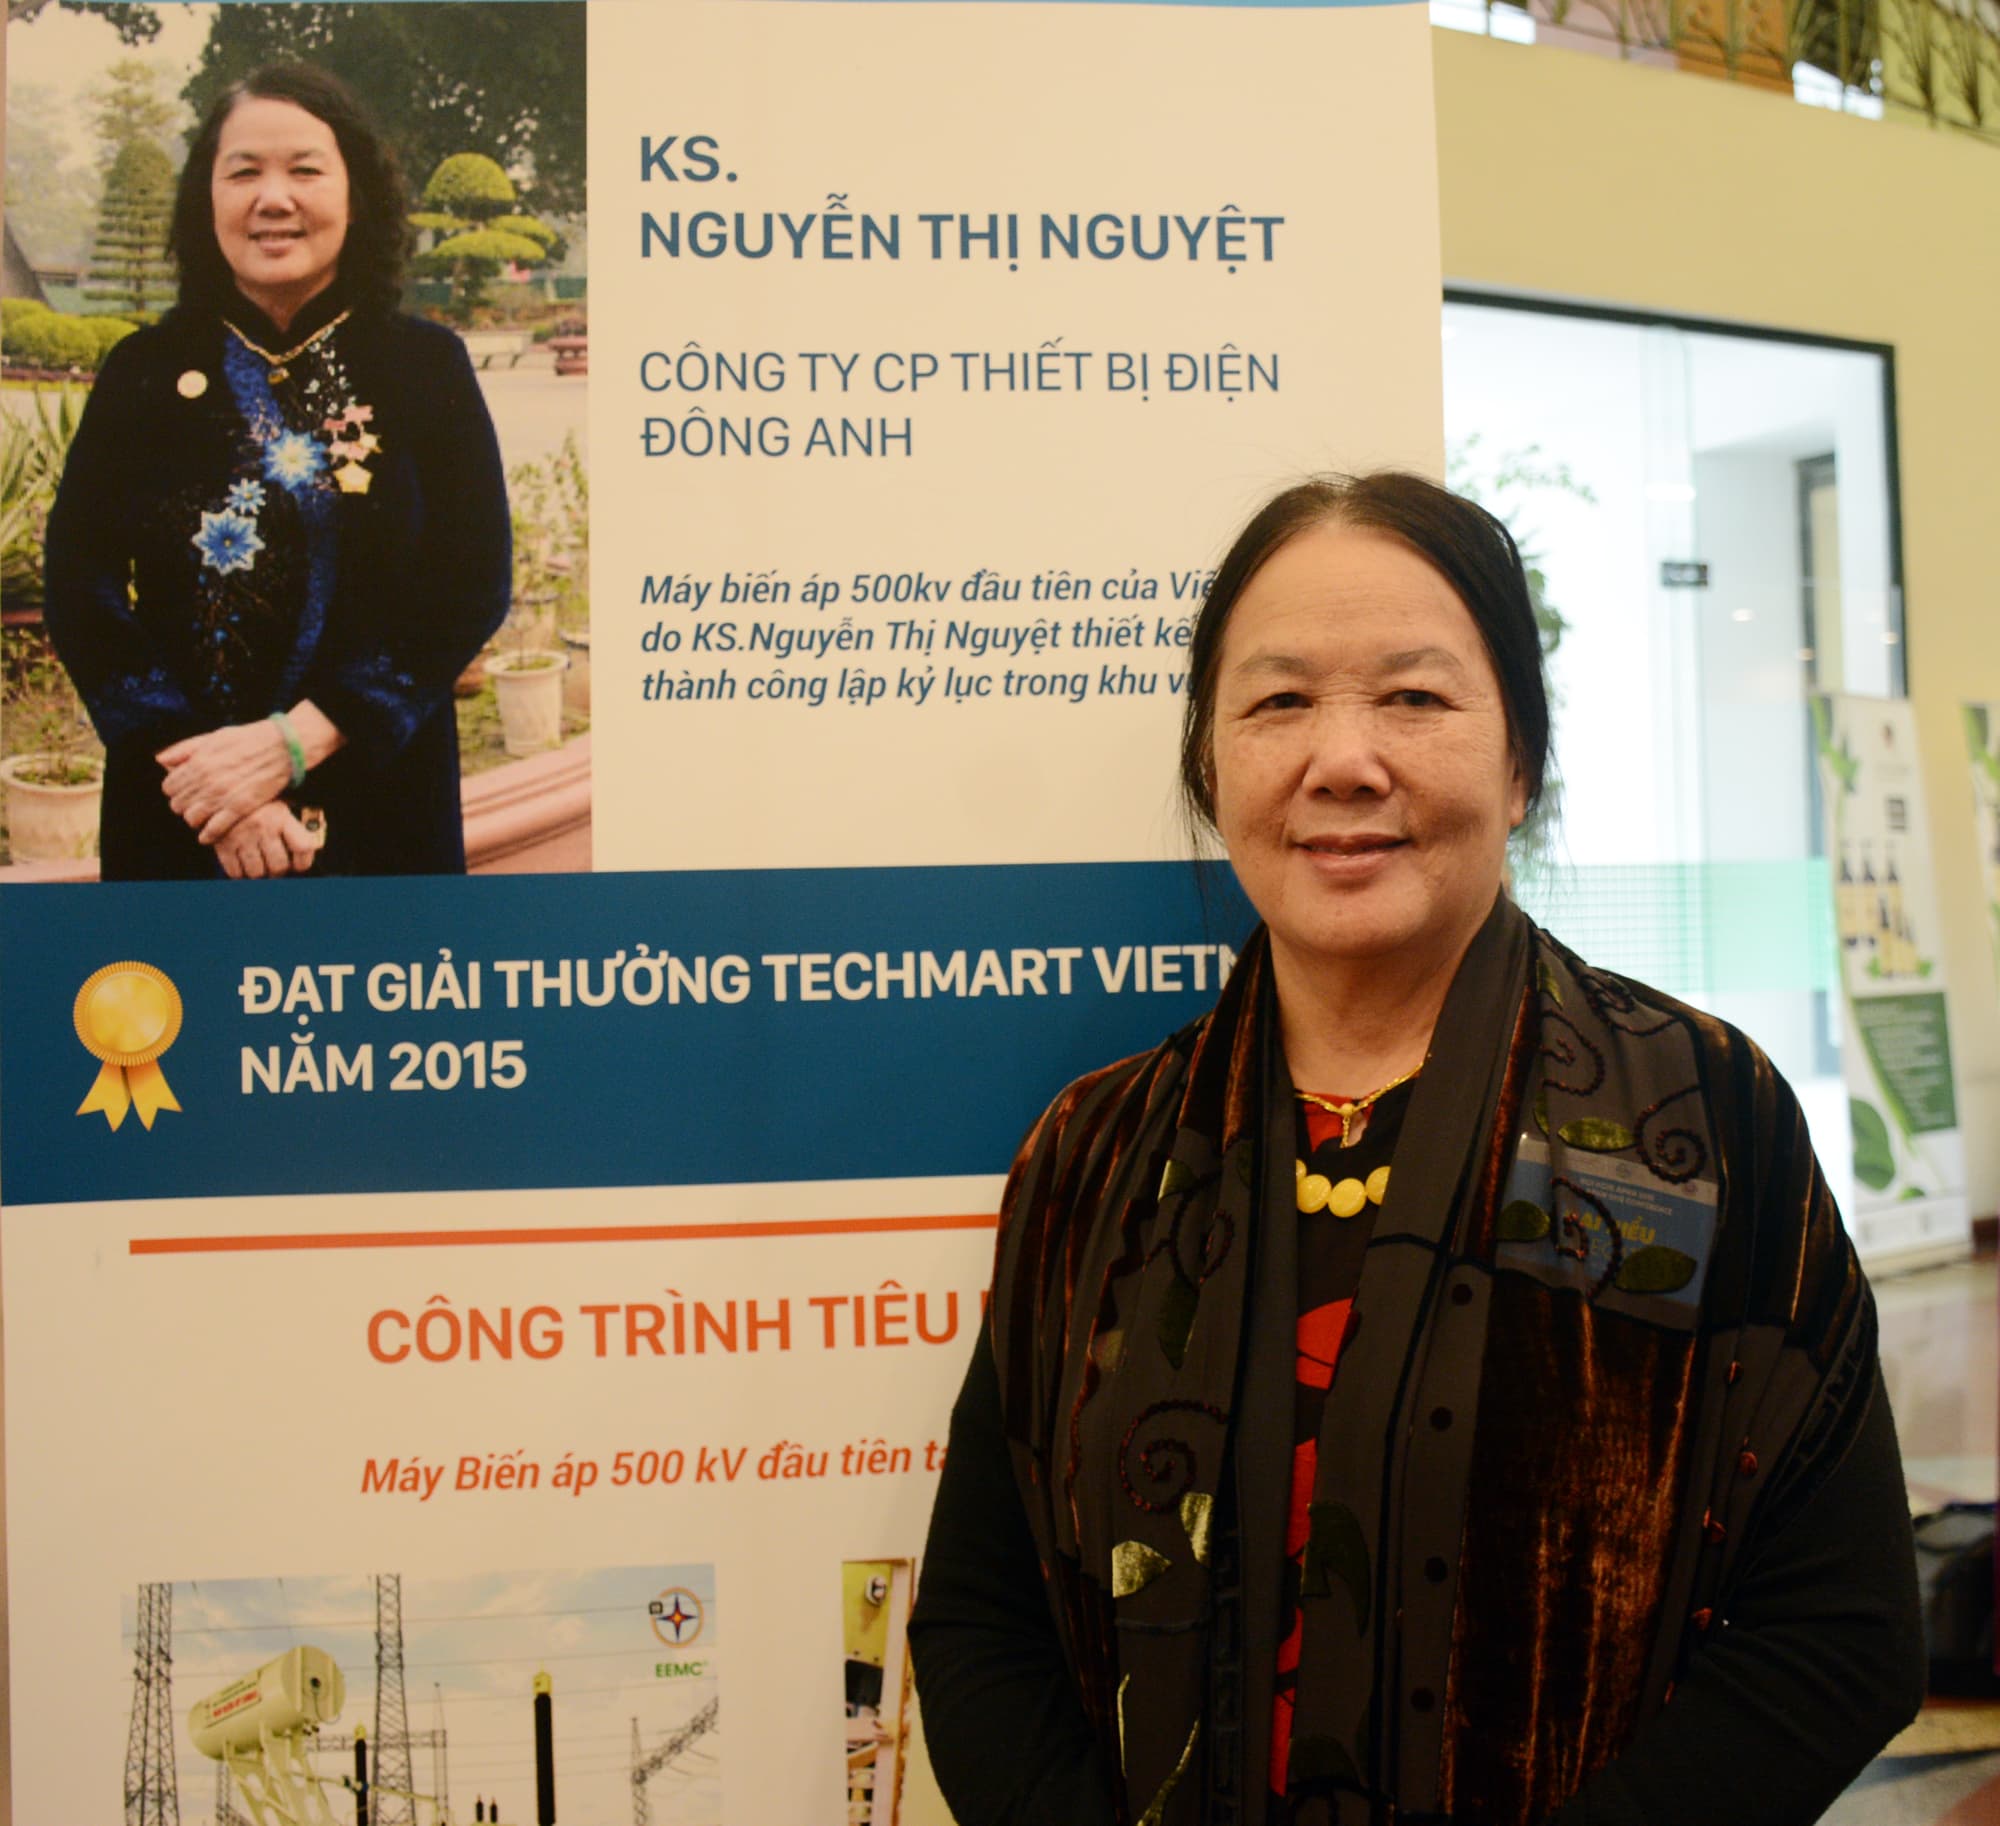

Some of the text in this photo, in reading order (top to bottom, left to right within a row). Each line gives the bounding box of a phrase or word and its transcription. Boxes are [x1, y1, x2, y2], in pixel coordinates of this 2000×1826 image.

[640, 135, 738, 183] KS.
[641, 193, 1285, 274] NGUYỄN THỊ NGUYỆT
[640, 337, 1279, 402] CÔNG TY CP THIẾT BỊ ĐIỆN
[639, 406, 912, 457] ĐÔNG ANH
[640, 574, 713, 612] Máy
[720, 570, 791, 604] biến
[800, 573, 841, 611] áp
[851, 571, 952, 603] 500kv
[960, 568, 1021, 602] đầu
[1032, 570, 1092, 601] tiên
[1101, 568, 1159, 601] của
[640, 621, 682, 653] do
[691, 616, 874, 660] KS.Nguyễn
[887, 619, 936, 657] Thị
[944, 618, 1062, 657] Nguyệt
[1072, 617, 1145, 648] thiết
[642, 664, 1194, 707] thành công lập kỷ lục trong khu v
[237, 964, 356, 1026] ĐẠT
[366, 947, 481, 1012] GIẢI
[493, 943, 751, 1009] THƯỞNG
[761, 947, 1083, 1002] TECHMART
[240, 1031, 527, 1095] NĂM 2015
[367, 1294, 564, 1365] CÔNG
[579, 1288, 791, 1358] TRÌNH
[808, 1279, 959, 1349] TIÊU
[360, 1456, 445, 1502] Máy
[454, 1449, 540, 1491] Biến
[551, 1452, 599, 1497] áp
[610, 1449, 685, 1486] 500
[695, 1446, 748, 1484] kV
[757, 1440, 829, 1481] đầu
[841, 1439, 912, 1476] tiên
[655, 1662, 704, 1678] EEMC
